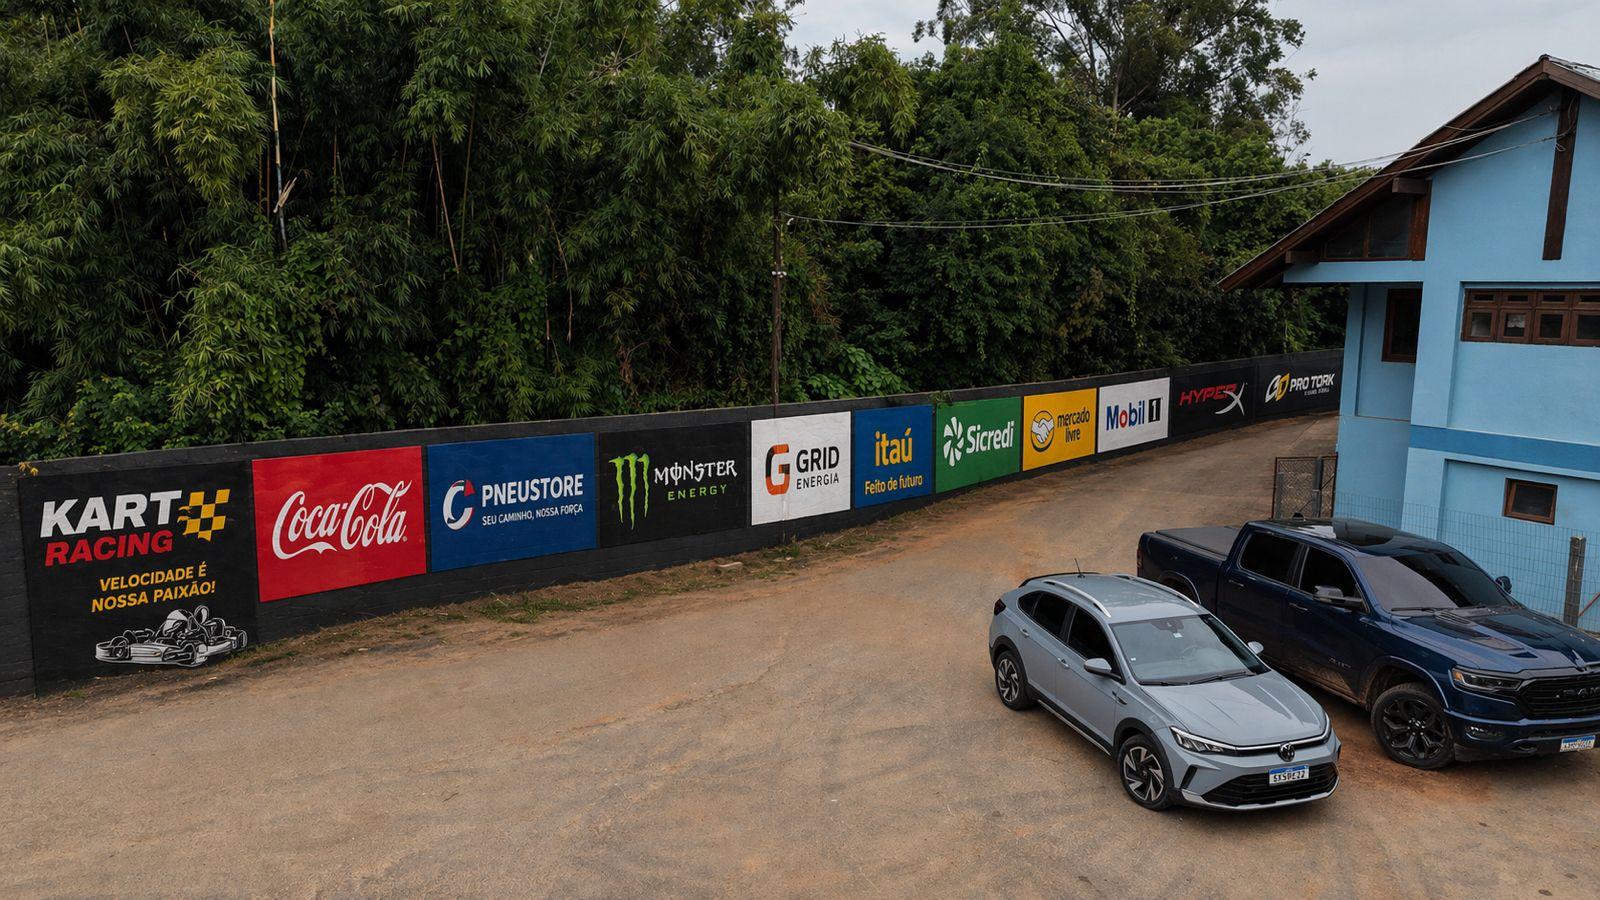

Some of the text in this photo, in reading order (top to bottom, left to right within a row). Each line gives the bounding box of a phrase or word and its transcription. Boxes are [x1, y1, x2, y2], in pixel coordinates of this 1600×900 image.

[1289, 376, 1310, 392] PRO
[1311, 373, 1335, 389] TORK
[1057, 407, 1090, 428] mercado
[1106, 400, 1145, 431] Mobil
[875, 428, 913, 467] itaú
[966, 421, 1015, 455] Sicredi
[1065, 428, 1081, 443] livre
[654, 459, 738, 486] MONSTER
[796, 446, 840, 473] GRID
[481, 474, 584, 508] PNEUSTORE
[667, 484, 728, 501] ENERGY
[796, 472, 840, 490] ENERGIA
[864, 475, 923, 495] Feito de futuro
[40, 490, 183, 538] KART
[272, 480, 412, 559] Coca-Cola
[482, 503, 584, 526] SEU CAMINHO, NOSSA FORÇA
[45, 529, 174, 567] RACING
[99, 561, 208, 592] VELOCIDADE É
[91, 580, 216, 613] NOSSA PAIXÃO!
